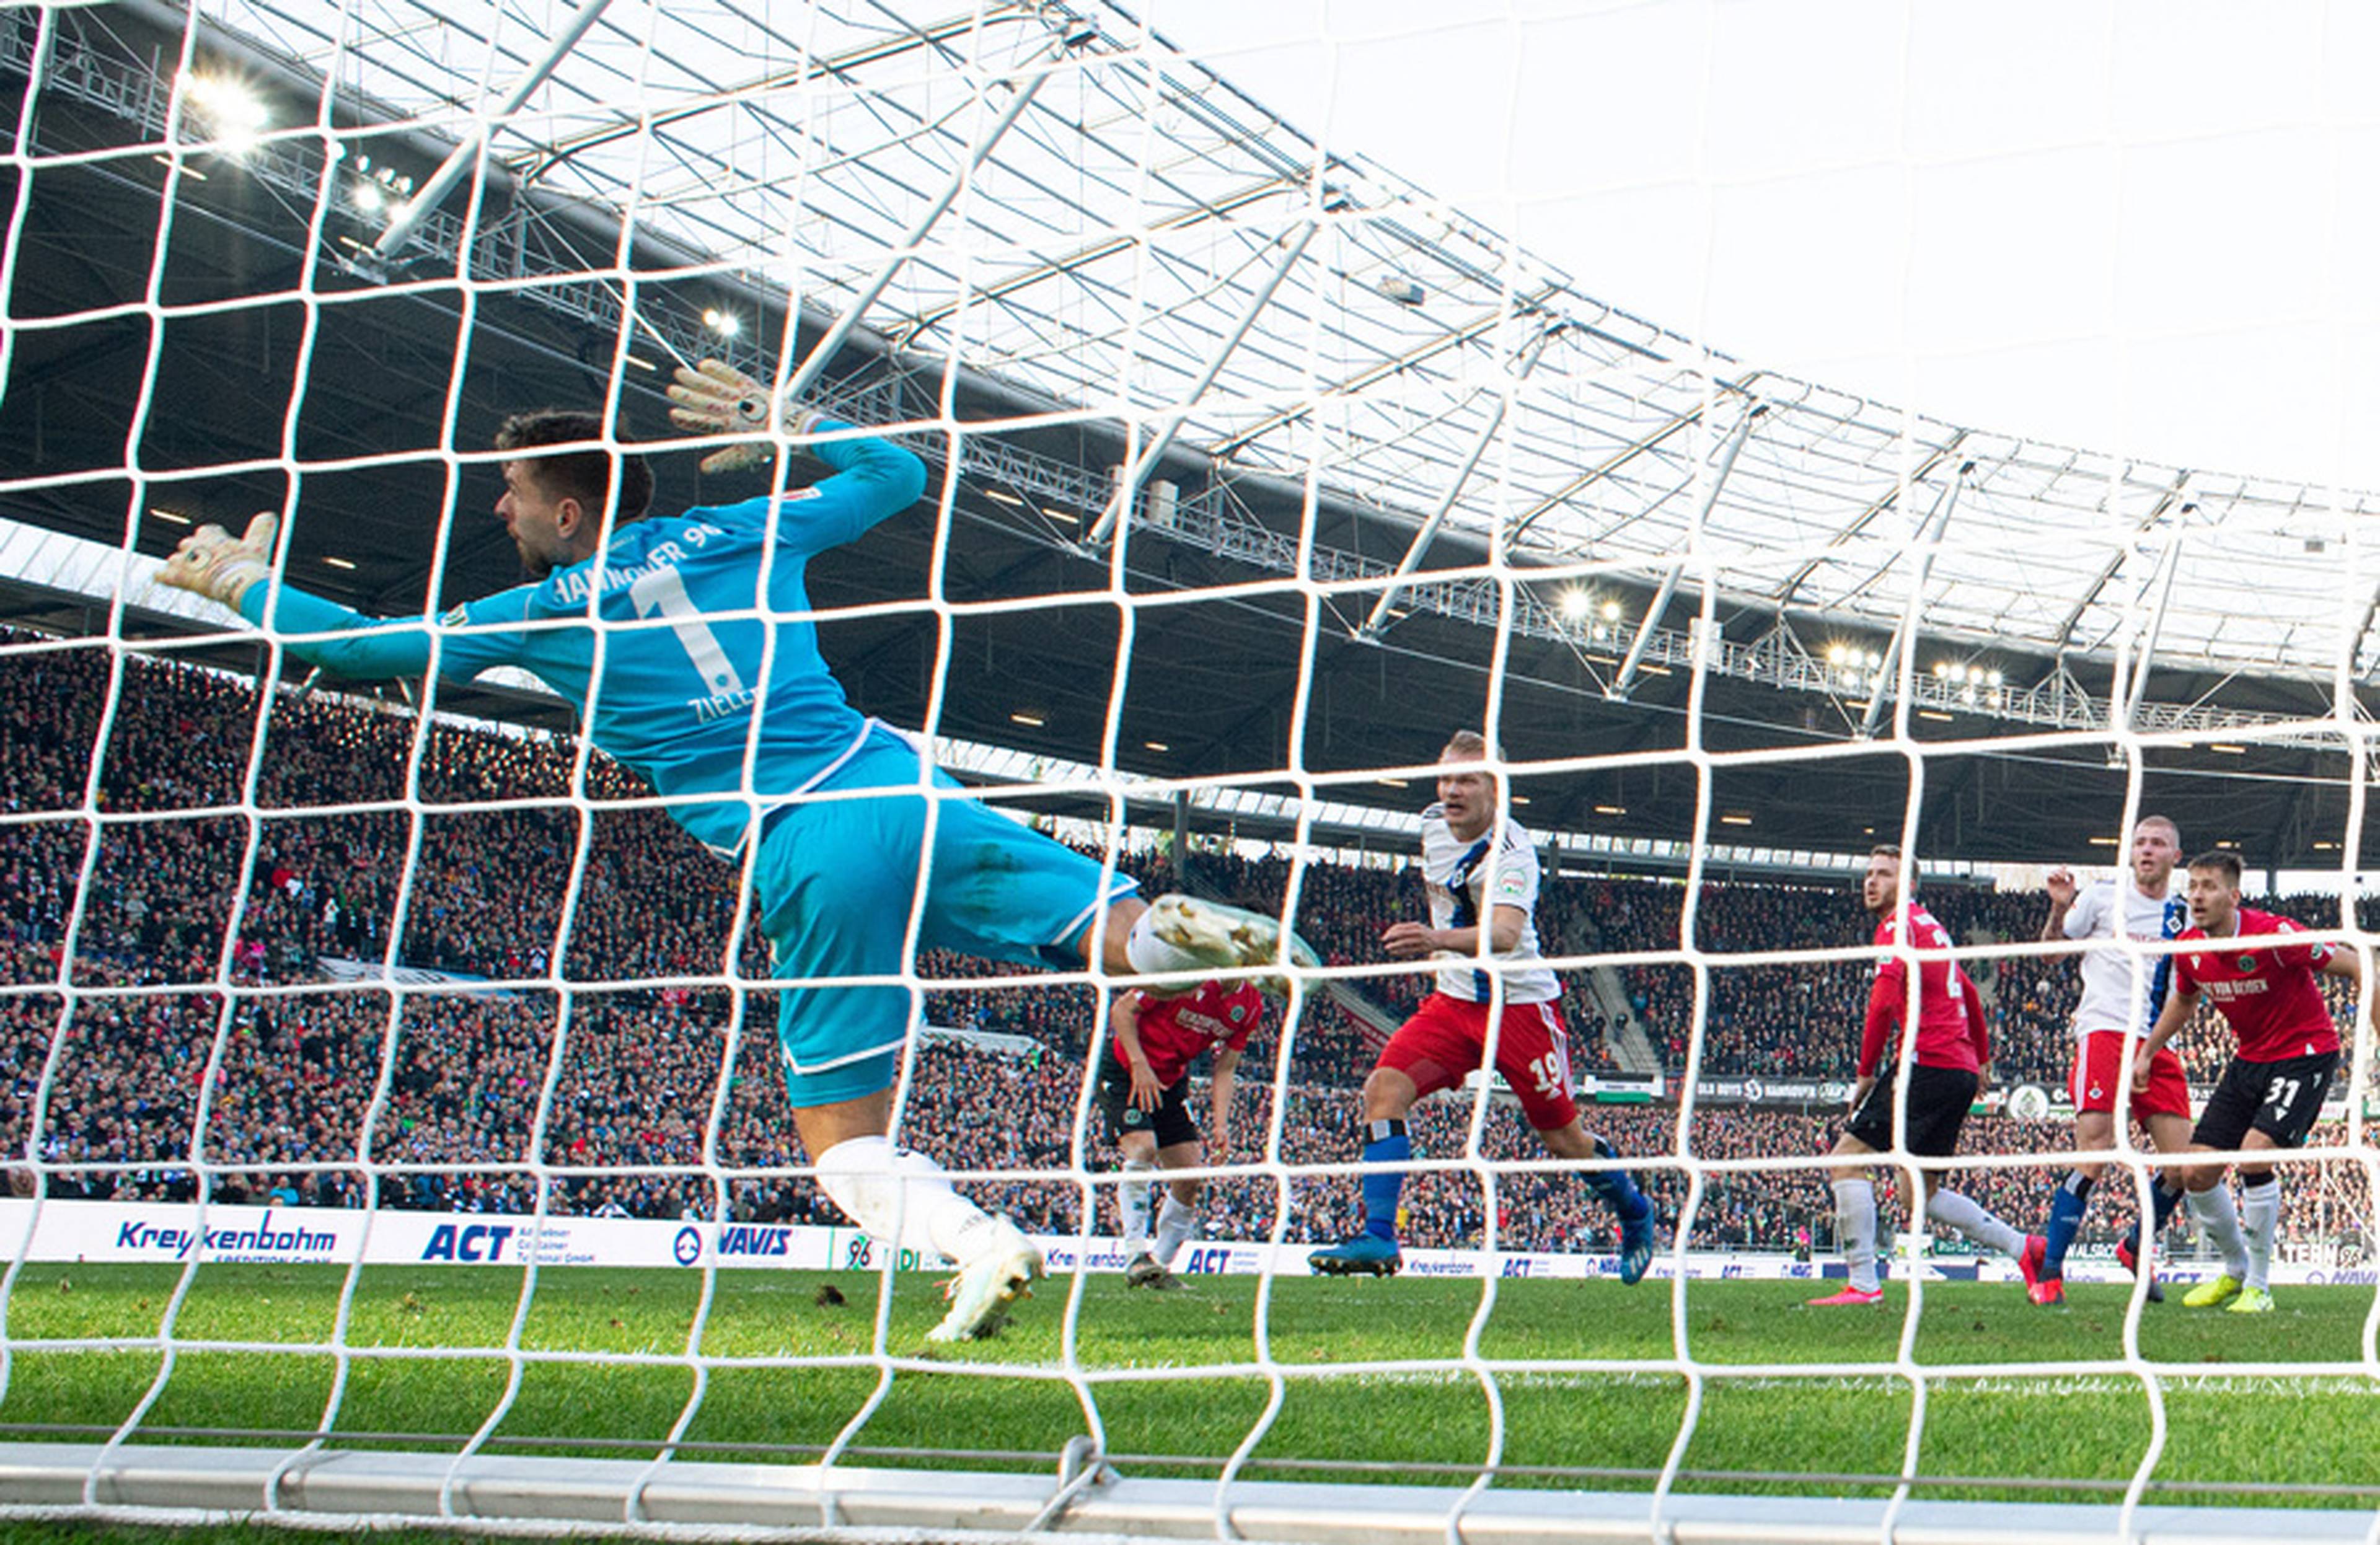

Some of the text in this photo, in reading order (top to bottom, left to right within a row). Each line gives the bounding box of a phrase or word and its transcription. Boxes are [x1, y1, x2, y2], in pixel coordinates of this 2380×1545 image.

[628, 564, 744, 697] 1
[1528, 1051, 1562, 1093] 19
[2263, 1076, 2301, 1108] 31
[117, 1209, 337, 1259] Kreykenbohm
[420, 1224, 514, 1262] ACT
[1186, 1249, 1231, 1274] ACT
[2331, 1271, 2378, 1284] NAVI
